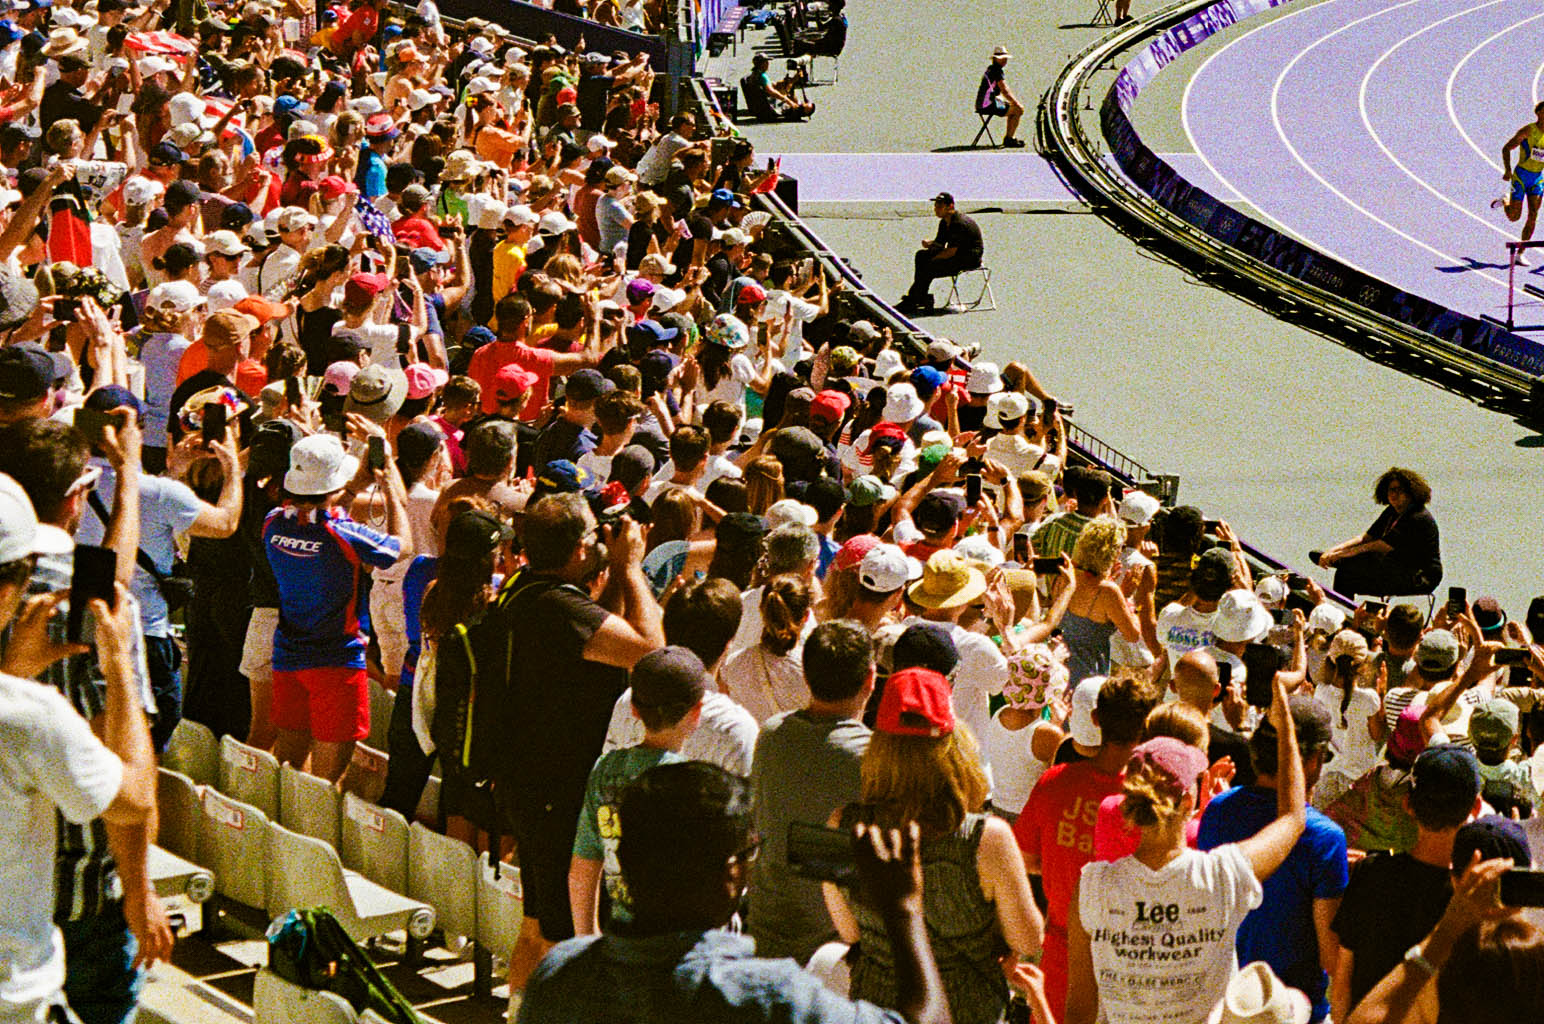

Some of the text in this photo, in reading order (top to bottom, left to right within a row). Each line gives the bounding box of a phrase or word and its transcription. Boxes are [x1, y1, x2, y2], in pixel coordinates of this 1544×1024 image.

[270, 534, 323, 554] FRANCE
[1135, 901, 1180, 924] Lee
[1095, 927, 1225, 949] Highest Quality
[1115, 946, 1203, 961] workwear
